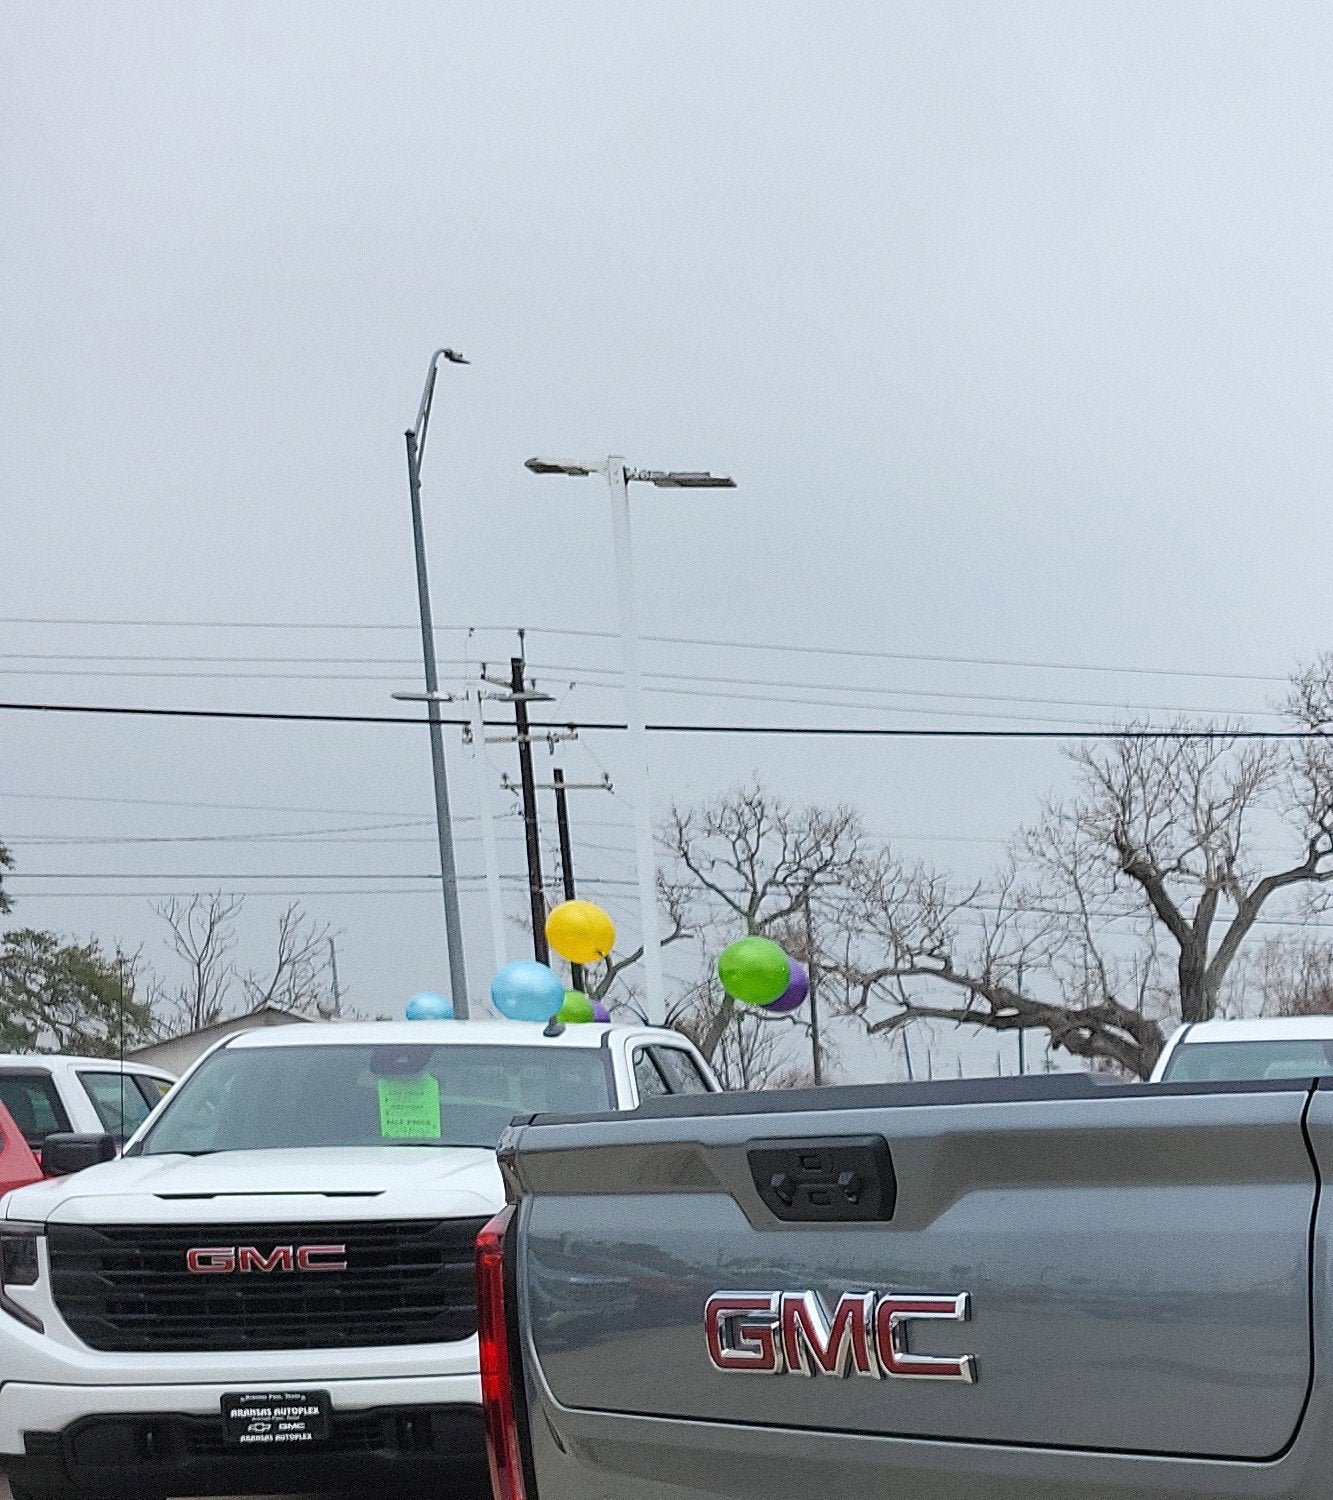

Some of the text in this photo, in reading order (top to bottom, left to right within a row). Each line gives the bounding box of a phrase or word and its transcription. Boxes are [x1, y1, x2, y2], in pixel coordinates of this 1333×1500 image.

[187, 1245, 347, 1273] GMC
[705, 1290, 977, 1383] GMC
[231, 1407, 272, 1418] ARANSAS
[274, 1406, 320, 1416] AUTOPLEX
[279, 1422, 306, 1431] GMC
